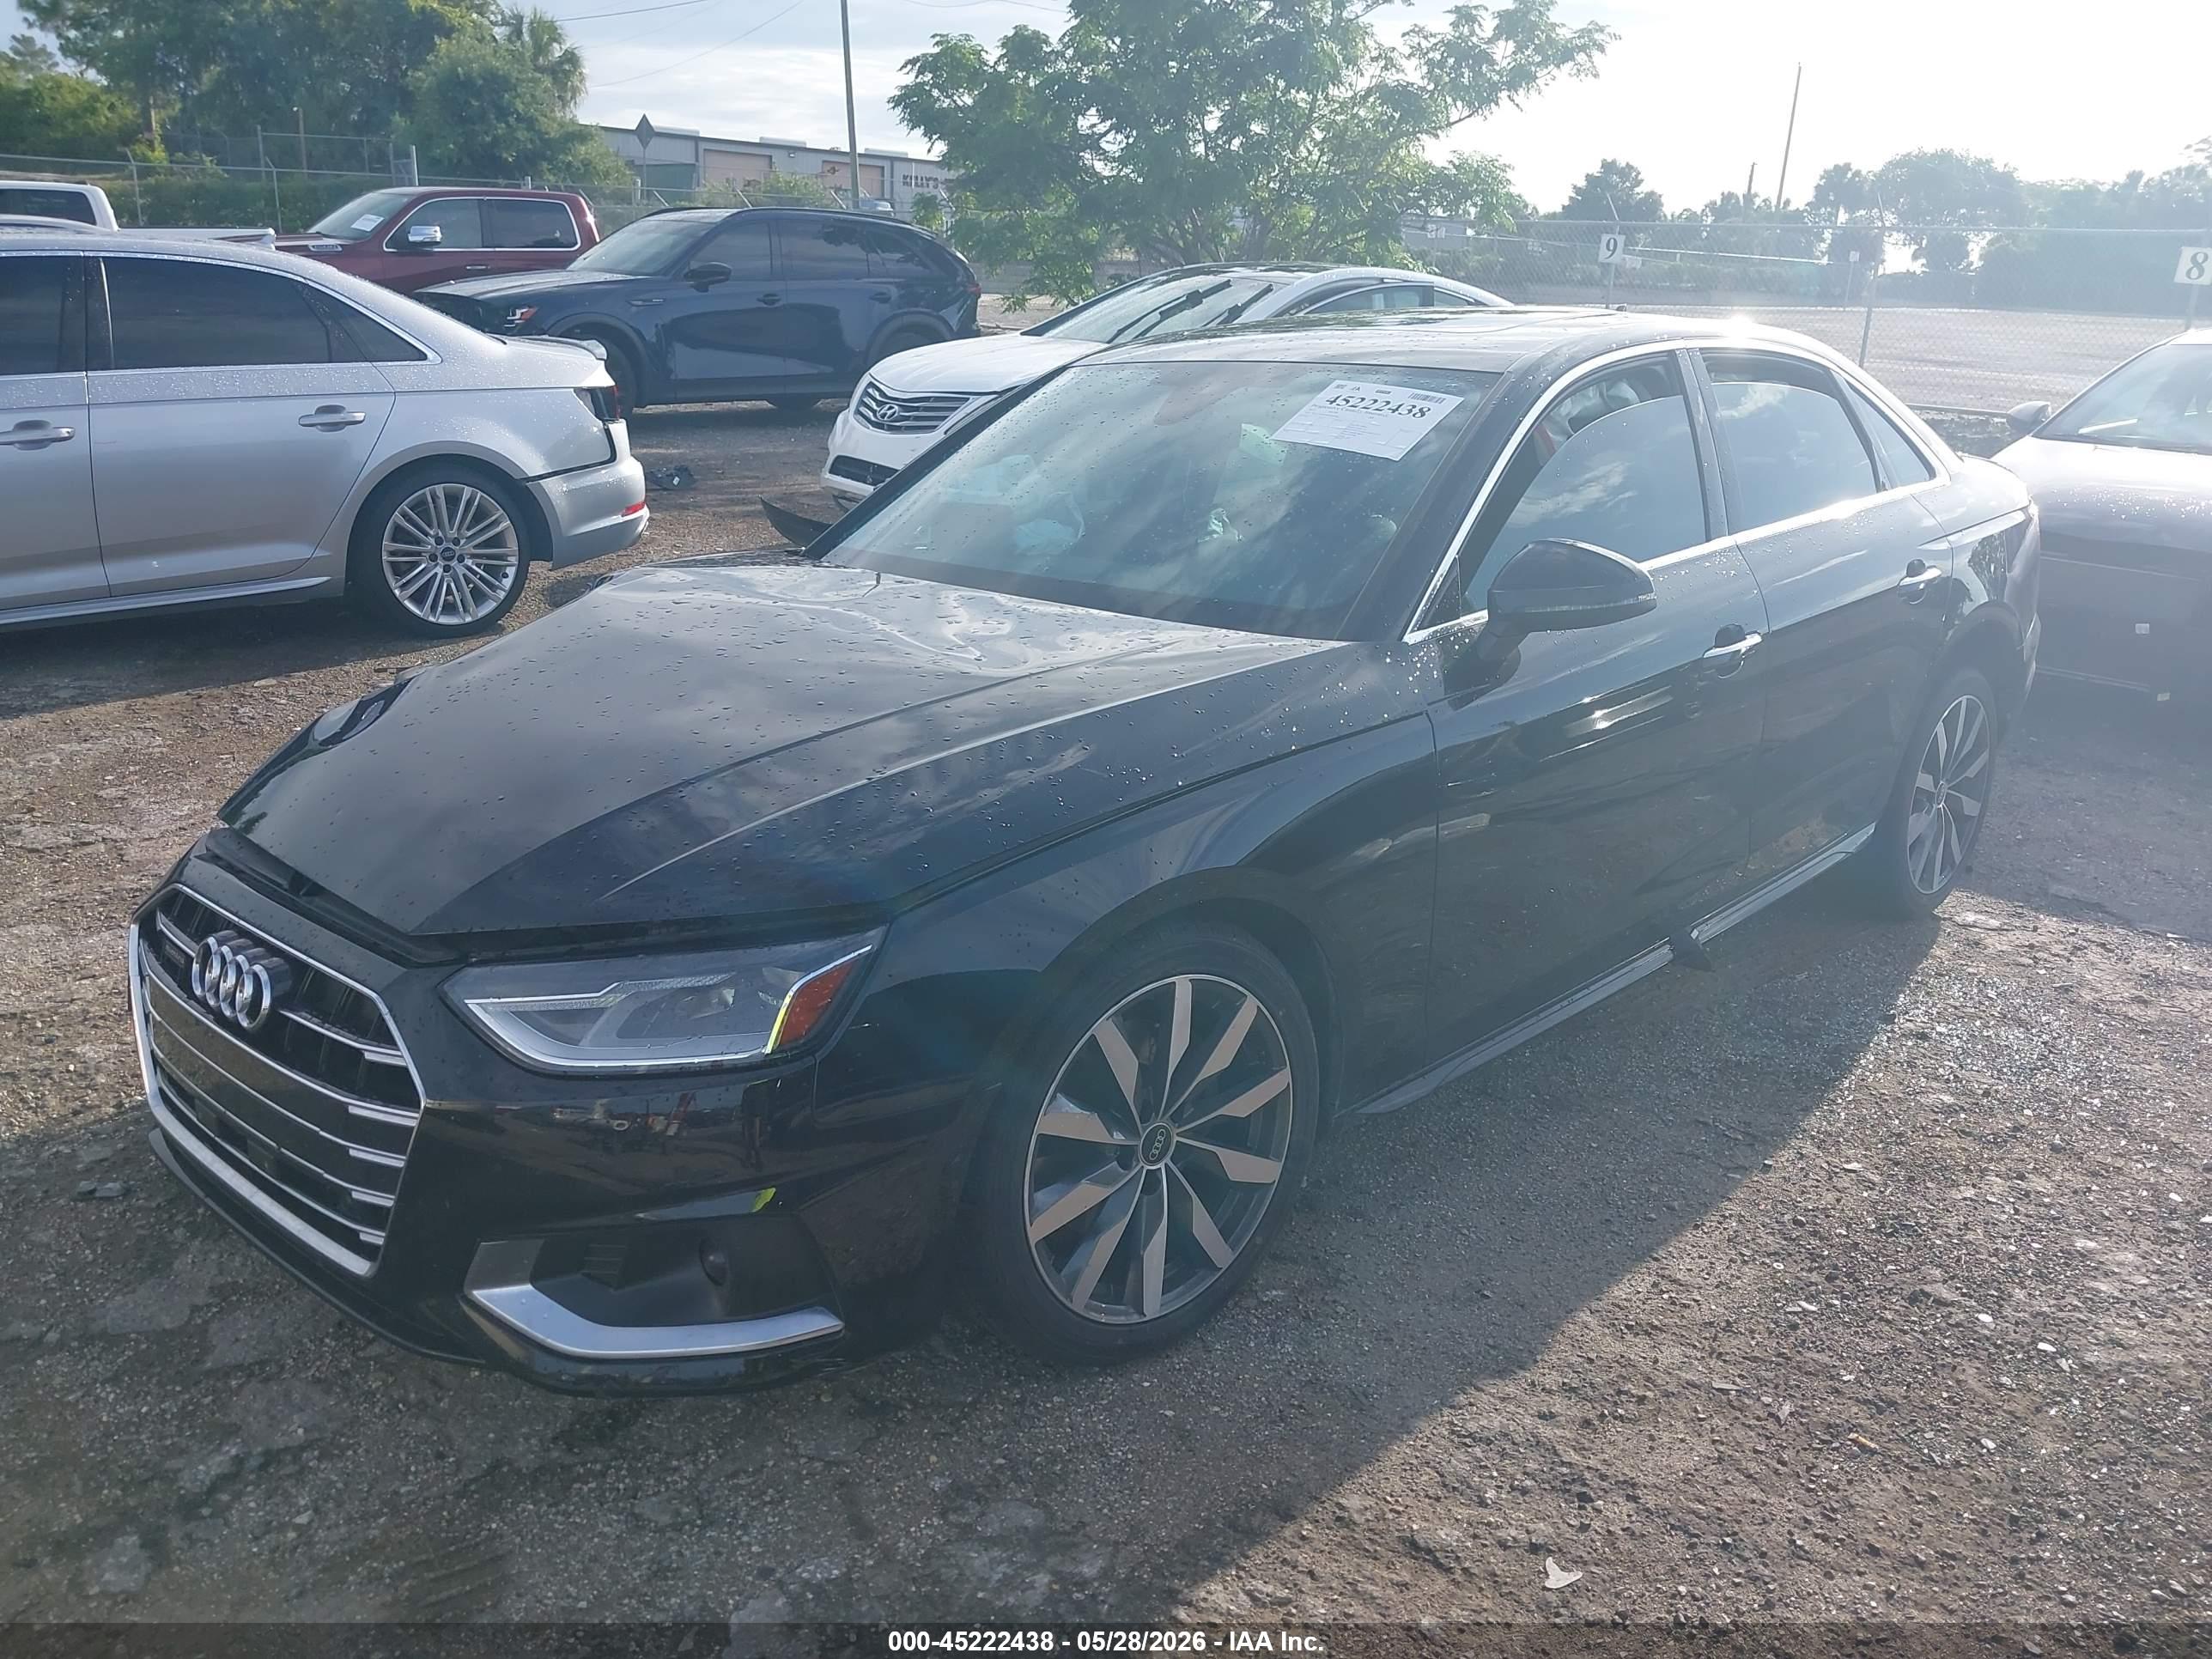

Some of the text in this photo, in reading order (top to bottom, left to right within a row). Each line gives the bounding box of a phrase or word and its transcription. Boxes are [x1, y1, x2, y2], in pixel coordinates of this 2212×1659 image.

[1605, 237, 1618, 259] 9
[2185, 252, 2209, 280] 8
[1326, 394, 1431, 418] 45222438
